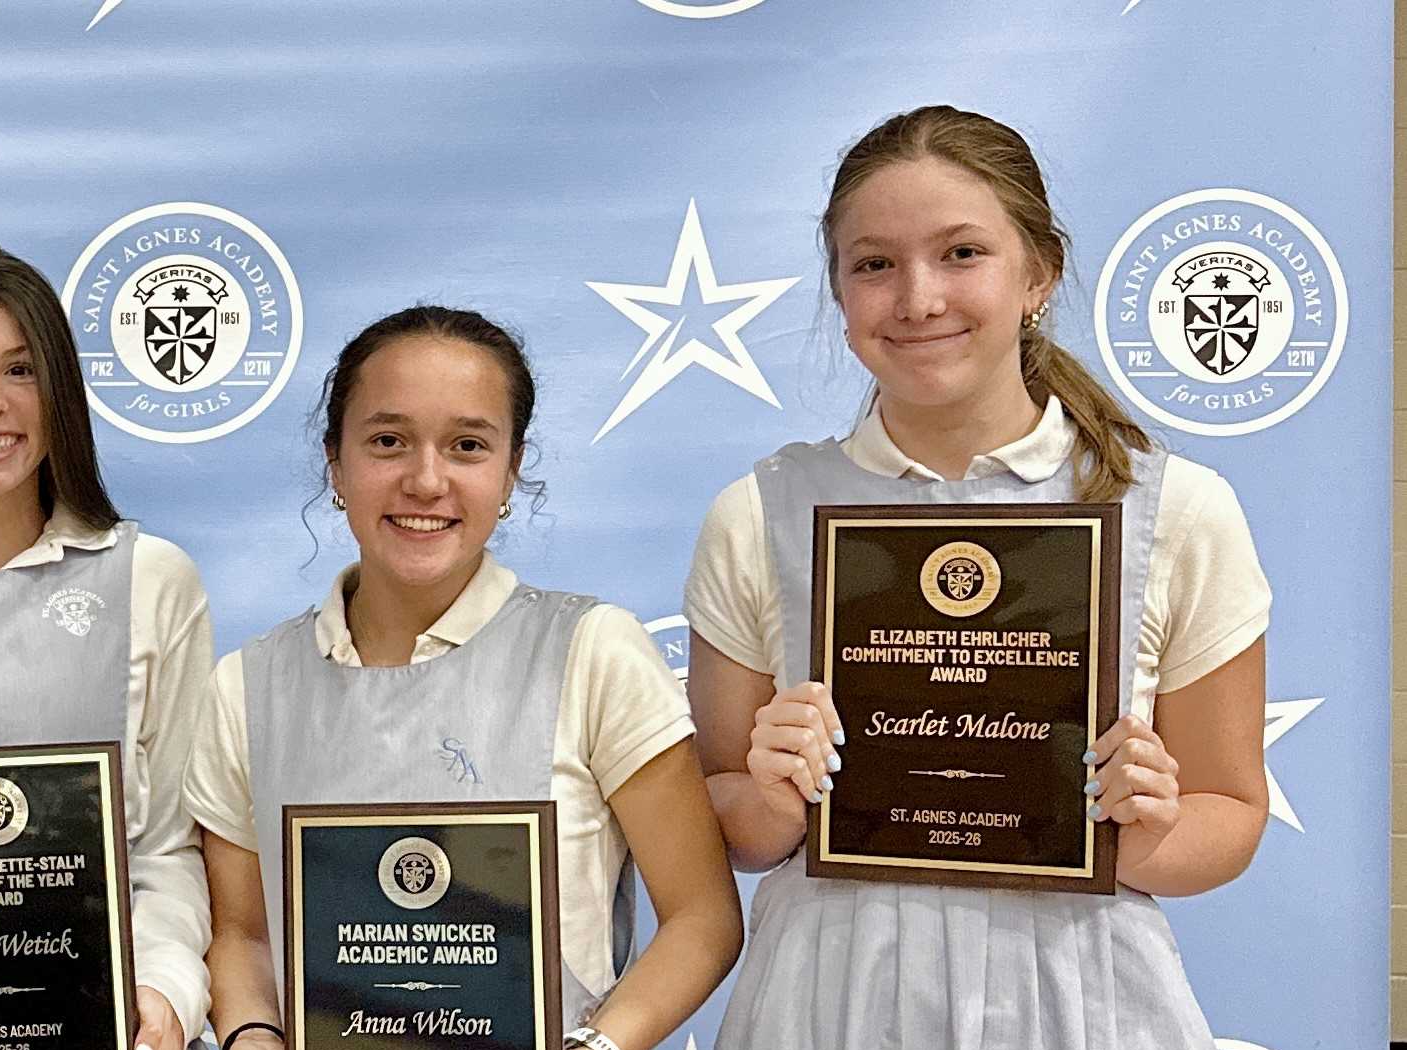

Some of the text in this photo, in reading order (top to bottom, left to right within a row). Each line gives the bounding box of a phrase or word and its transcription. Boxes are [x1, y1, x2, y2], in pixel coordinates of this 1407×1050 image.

[1120, 213, 1323, 327] SAINT AGNES ACADEMY
[1188, 256, 1254, 272] VERITAS
[83, 227, 278, 337] SAINT AGNES ACADEMY
[148, 268, 213, 285] VERITAS
[1262, 300, 1283, 314] 1851
[220, 311, 241, 325] 1851
[1128, 350, 1316, 367] PK2 12TH
[91, 360, 271, 377] PK2 12TH
[125, 391, 232, 418] for GIRLS
[1163, 381, 1275, 410] for GIRLS
[870, 629, 1051, 648] ELIZABETH EHRLICHER
[841, 646, 1080, 667] COMMITMENT TO EXCELLENCE
[929, 666, 987, 683] AWARD
[864, 709, 1051, 741] Scarlet Malone
[890, 808, 1022, 828] ST. AGNES ACADEMY
[928, 830, 982, 847] 2025-26
[8, 874, 34, 889] THE
[37, 872, 74, 888] YEAR
[338, 924, 496, 943] MARIAN SWICKER
[337, 945, 498, 965] ACADEMIC AWARD
[10, 1023, 63, 1039] ACADEMY
[341, 1008, 493, 1037] Anna Wilson
